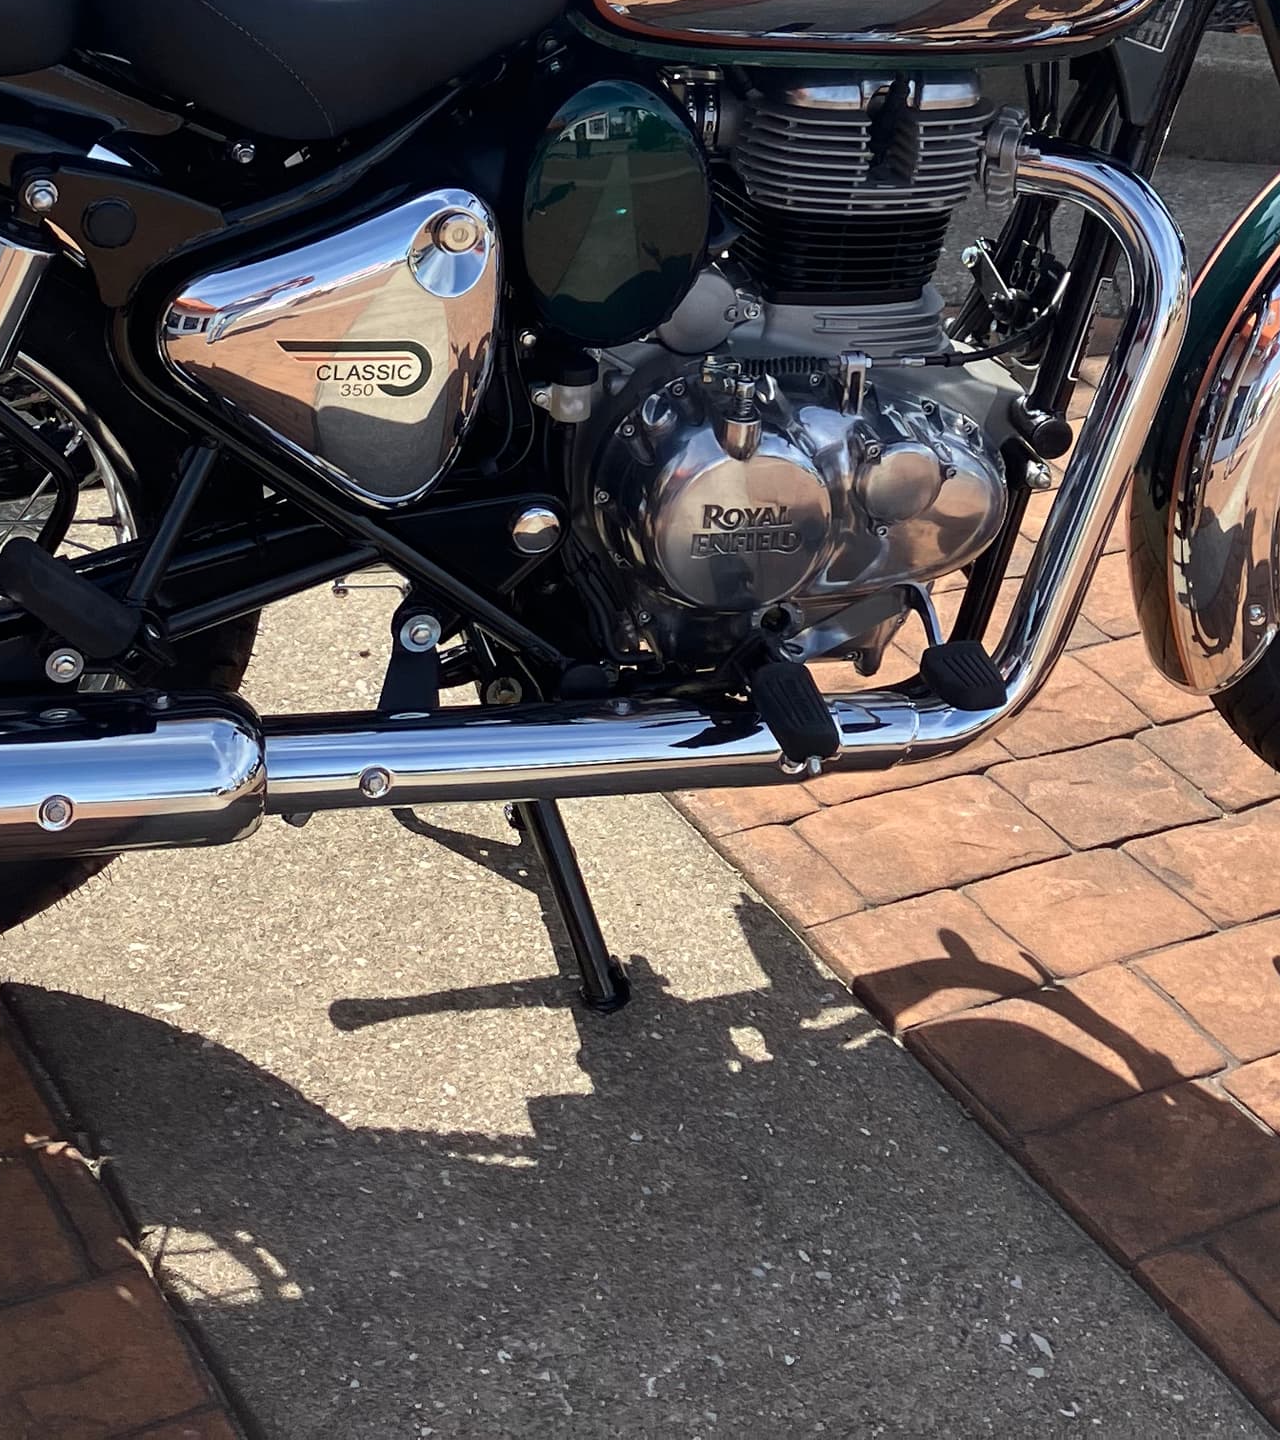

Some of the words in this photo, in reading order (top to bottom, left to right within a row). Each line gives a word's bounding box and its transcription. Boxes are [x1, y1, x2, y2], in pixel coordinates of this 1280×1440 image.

[317, 364, 412, 381] CLASSIC
[341, 383, 374, 397] 350
[702, 504, 793, 530] ROYAL
[690, 530, 803, 559] ENFIELD
